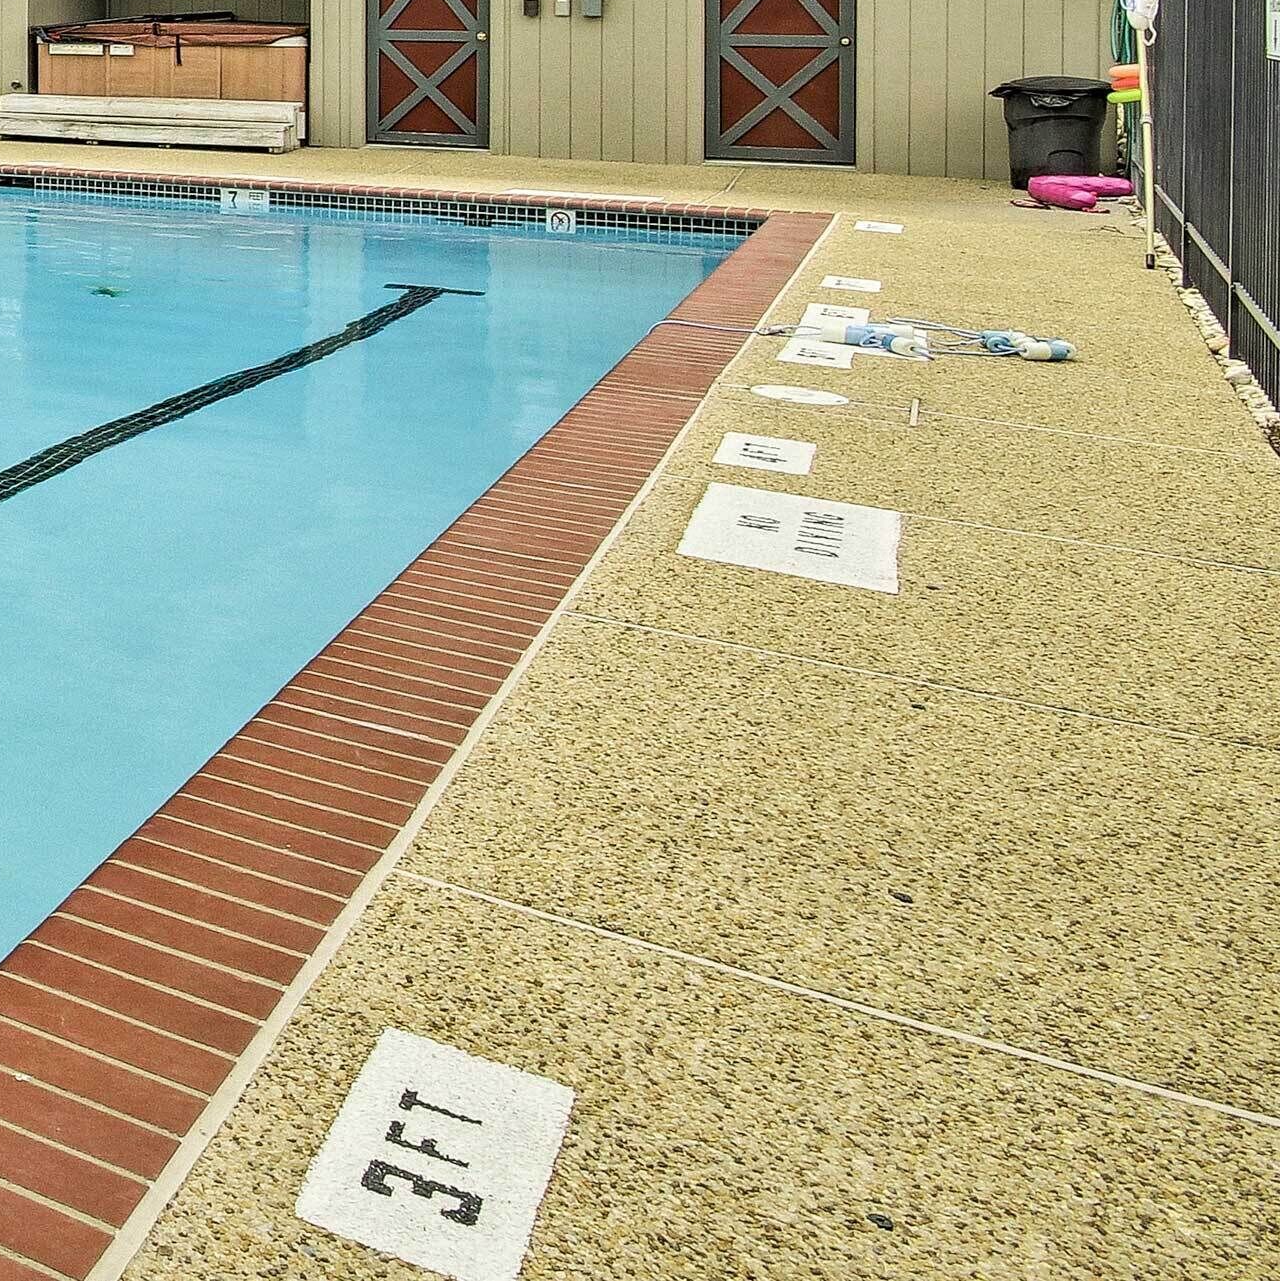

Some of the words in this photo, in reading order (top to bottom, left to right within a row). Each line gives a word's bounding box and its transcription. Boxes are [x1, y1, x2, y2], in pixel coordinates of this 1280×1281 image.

[736, 514, 781, 533] NO
[794, 511, 845, 558] DIVING
[360, 1087, 483, 1226] 3FT
